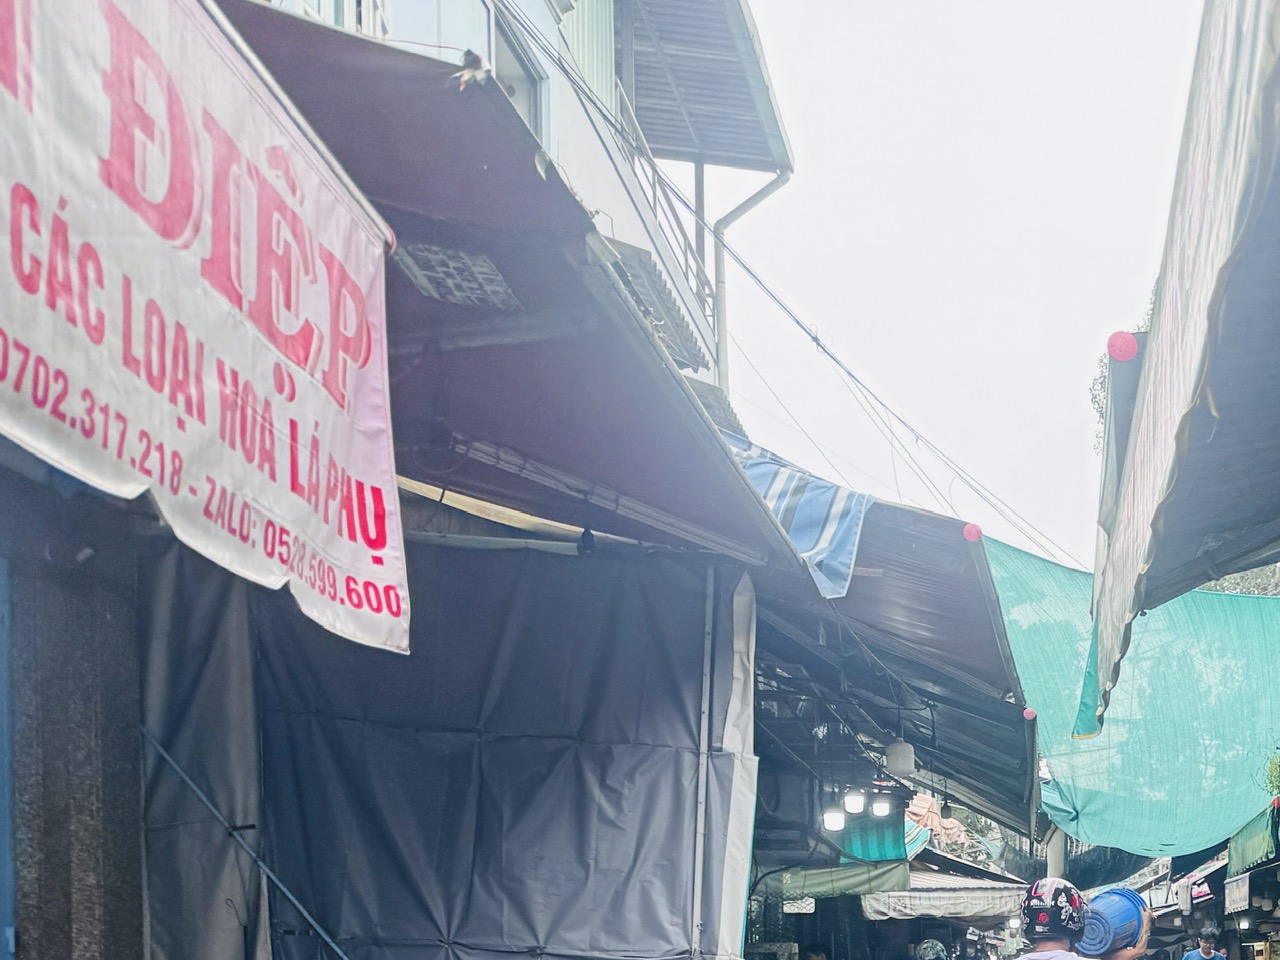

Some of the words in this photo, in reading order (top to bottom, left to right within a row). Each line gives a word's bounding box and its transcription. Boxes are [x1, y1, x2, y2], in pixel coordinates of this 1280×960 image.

[10, 182, 105, 347] CÁC
[122, 273, 207, 433] LOẠI
[216, 356, 277, 484] HOA
[289, 417, 321, 515] LÁ
[322, 452, 388, 567] PHỤ
[98, 0, 371, 412] ĐIỆP
[203, 474, 257, 549] ZALO:
[263, 518, 402, 618] 0528.599.600
